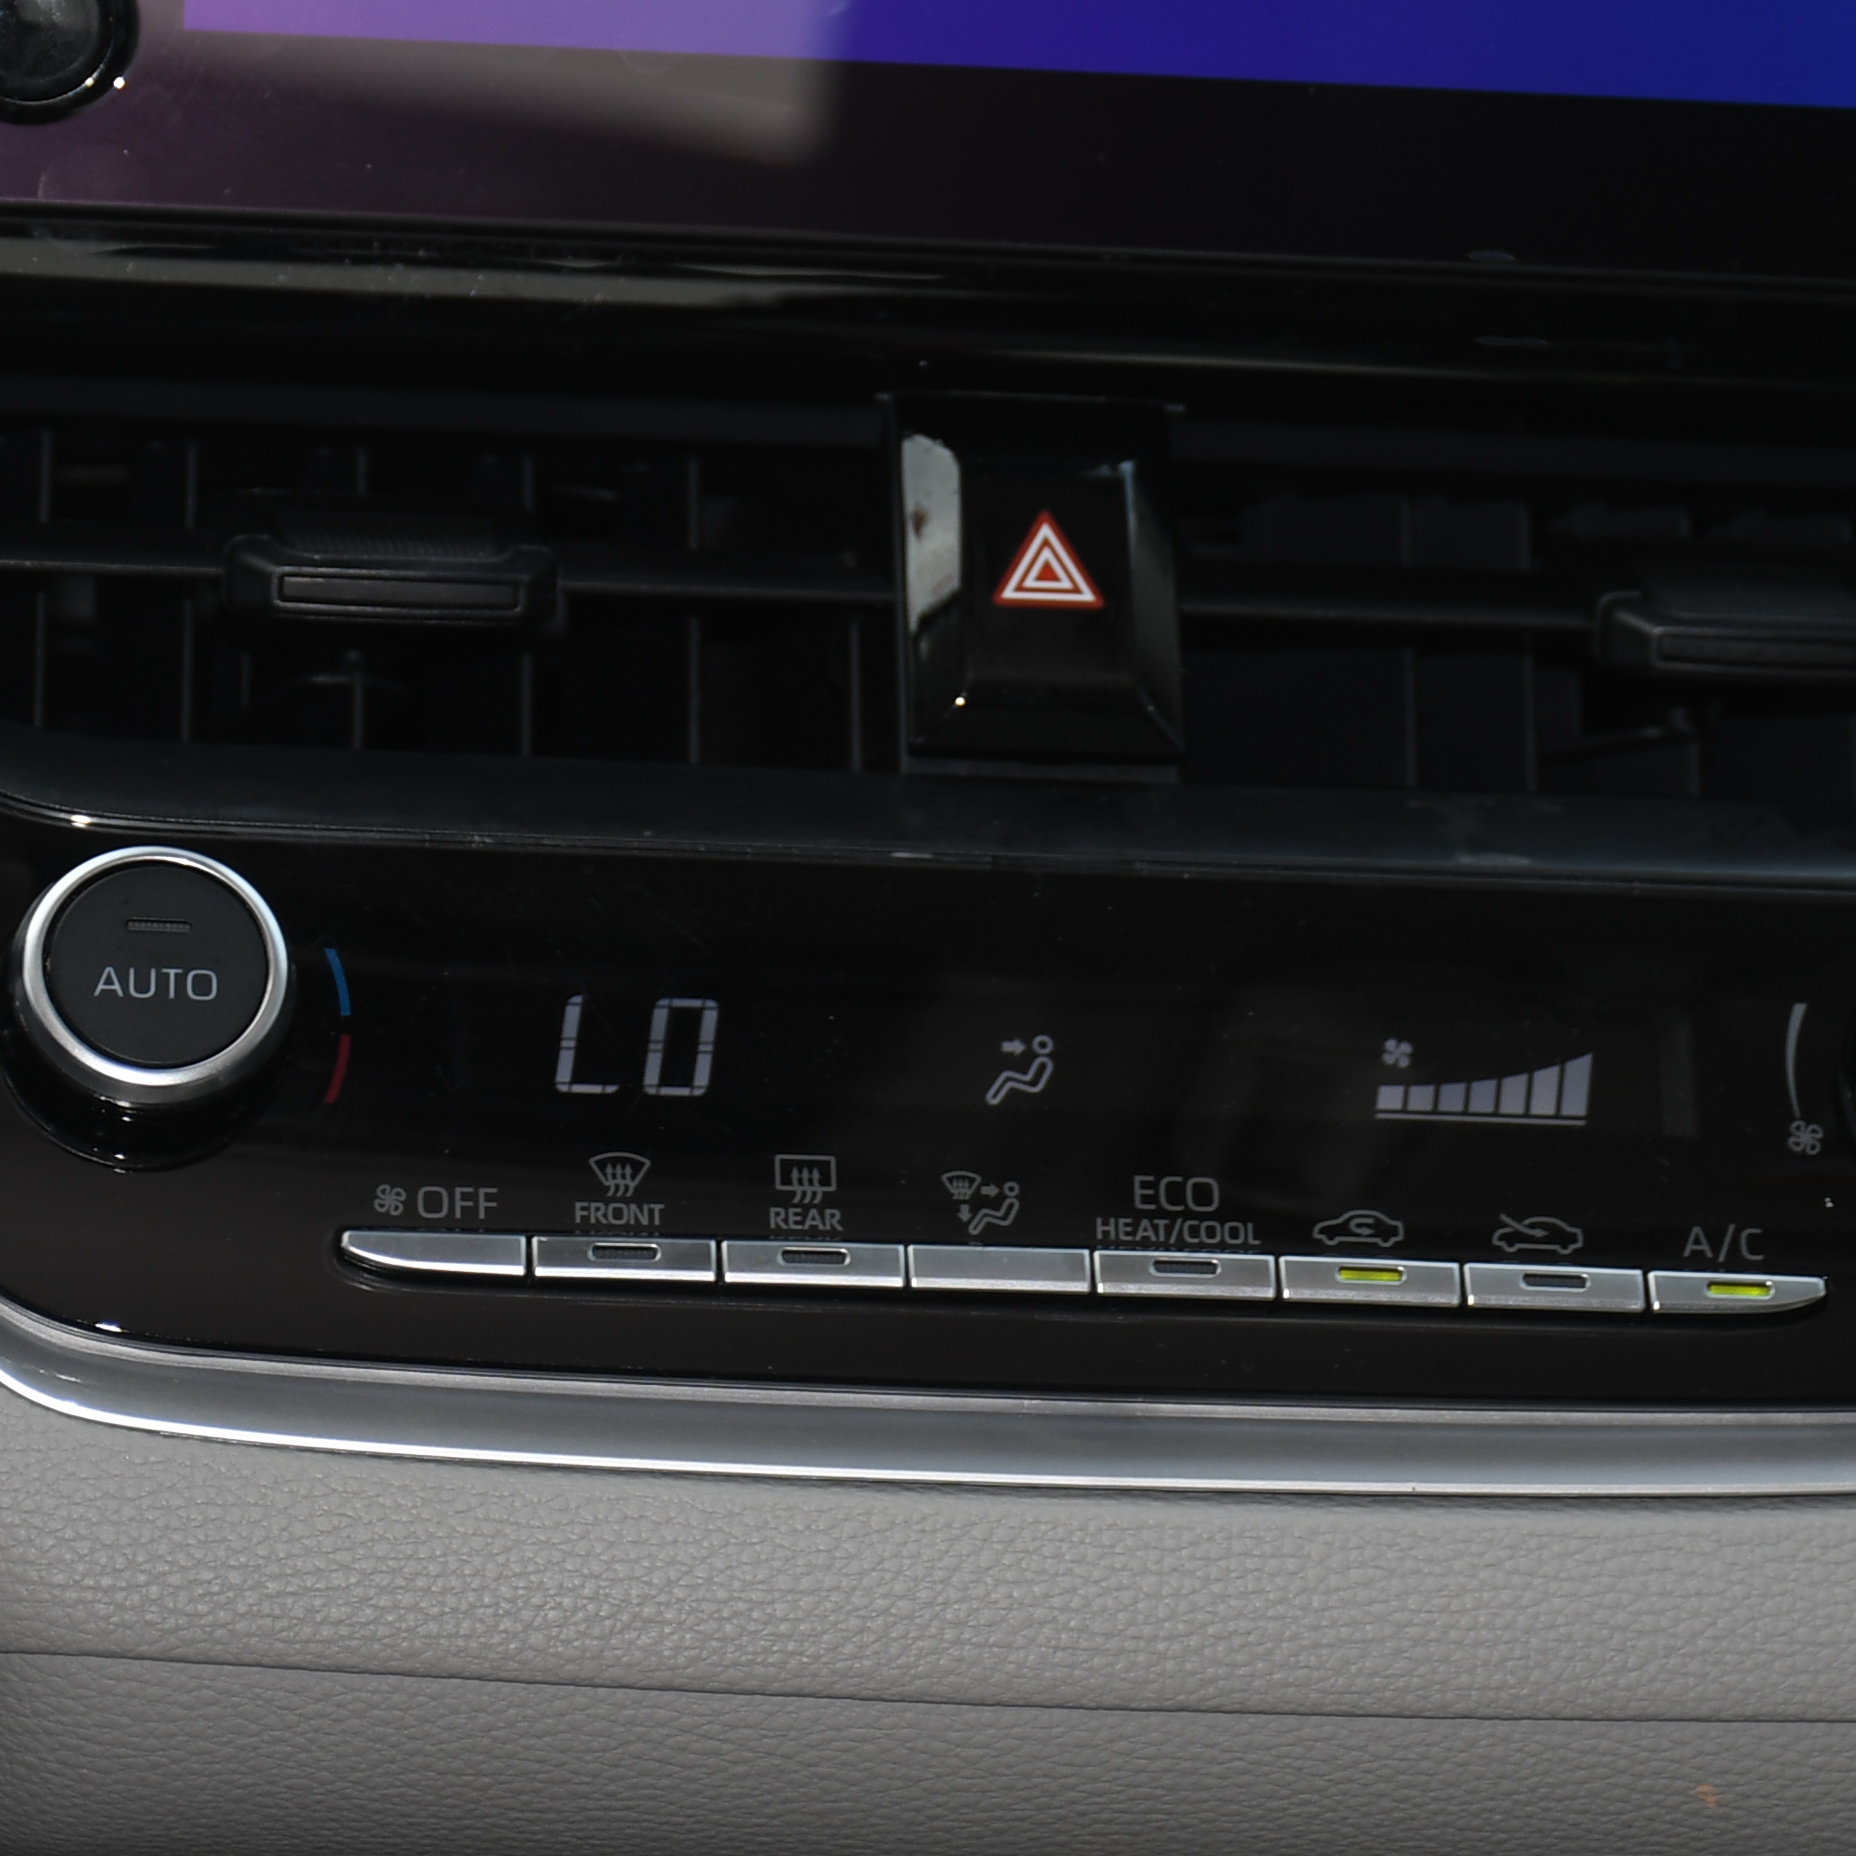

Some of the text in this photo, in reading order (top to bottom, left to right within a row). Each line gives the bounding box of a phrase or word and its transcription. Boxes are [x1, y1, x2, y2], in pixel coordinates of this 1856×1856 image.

[92, 965, 220, 1002] AUTO
[553, 994, 720, 1096] LO
[416, 1186, 499, 1221] OFF
[1133, 1174, 1220, 1212] ECO
[574, 1201, 665, 1228] FRONT
[769, 1206, 843, 1231] REAR
[1096, 1217, 1262, 1245] HEAT/COOL
[1681, 1224, 1765, 1263] A/C
